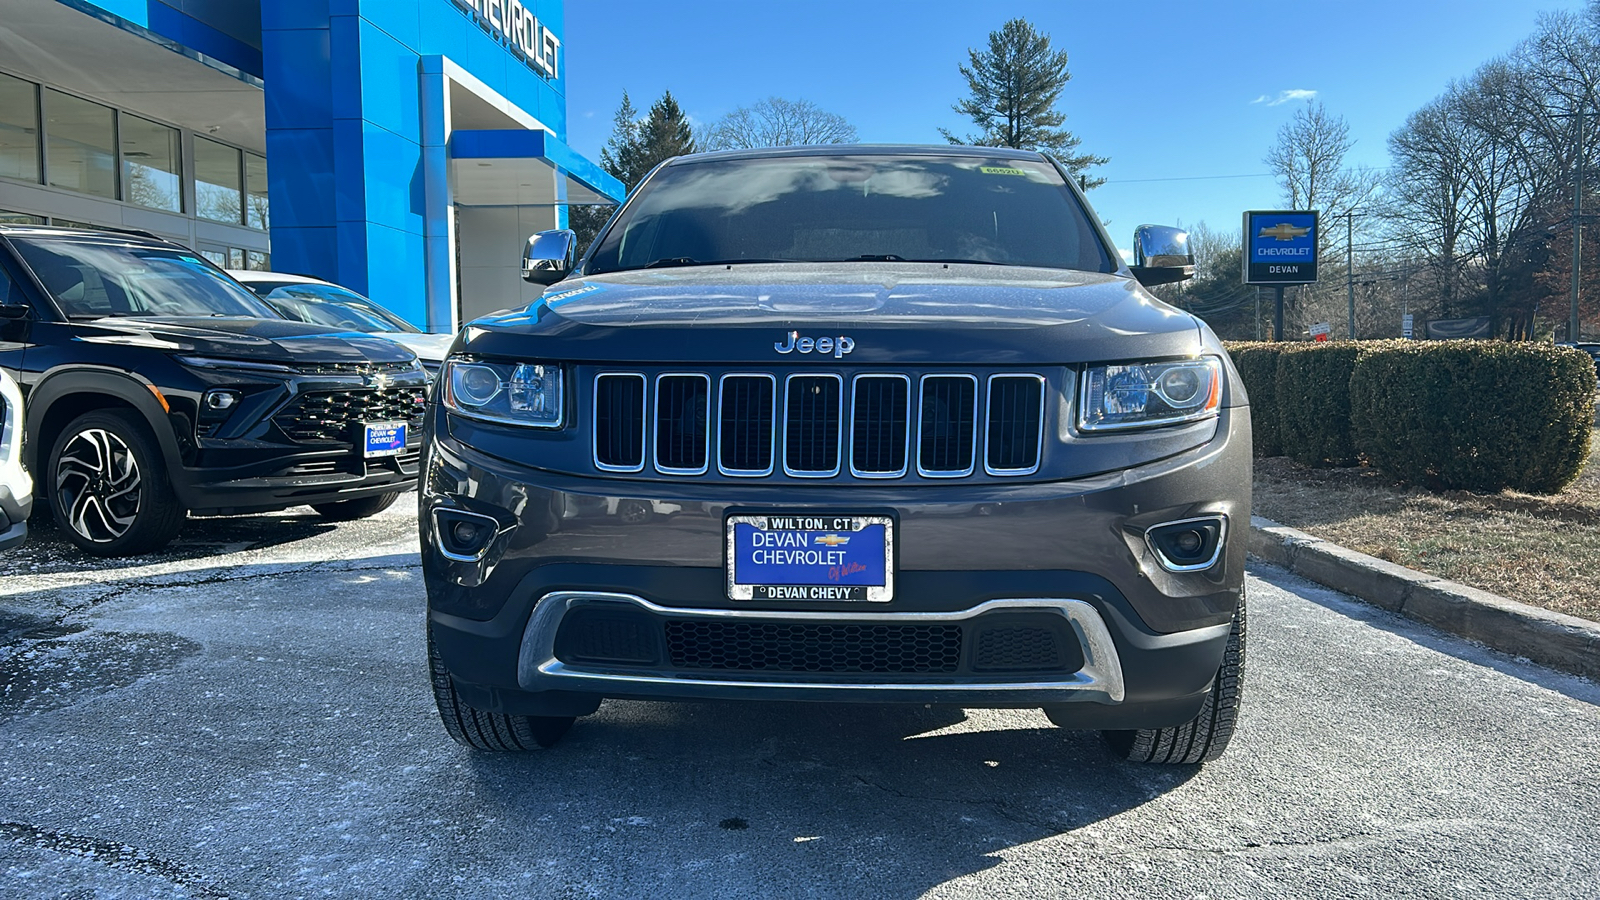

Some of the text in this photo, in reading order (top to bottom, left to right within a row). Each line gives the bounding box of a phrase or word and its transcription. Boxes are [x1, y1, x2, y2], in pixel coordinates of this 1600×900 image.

[1258, 247, 1310, 256] CHEVROLET
[1269, 265, 1299, 274] DEVAN
[774, 331, 855, 358] Jeep
[772, 518, 851, 530] WILTON, CT
[752, 532, 808, 547] DEVAN
[752, 550, 846, 565] CHEVROLET
[768, 586, 851, 599] DEVAN CHEVY
